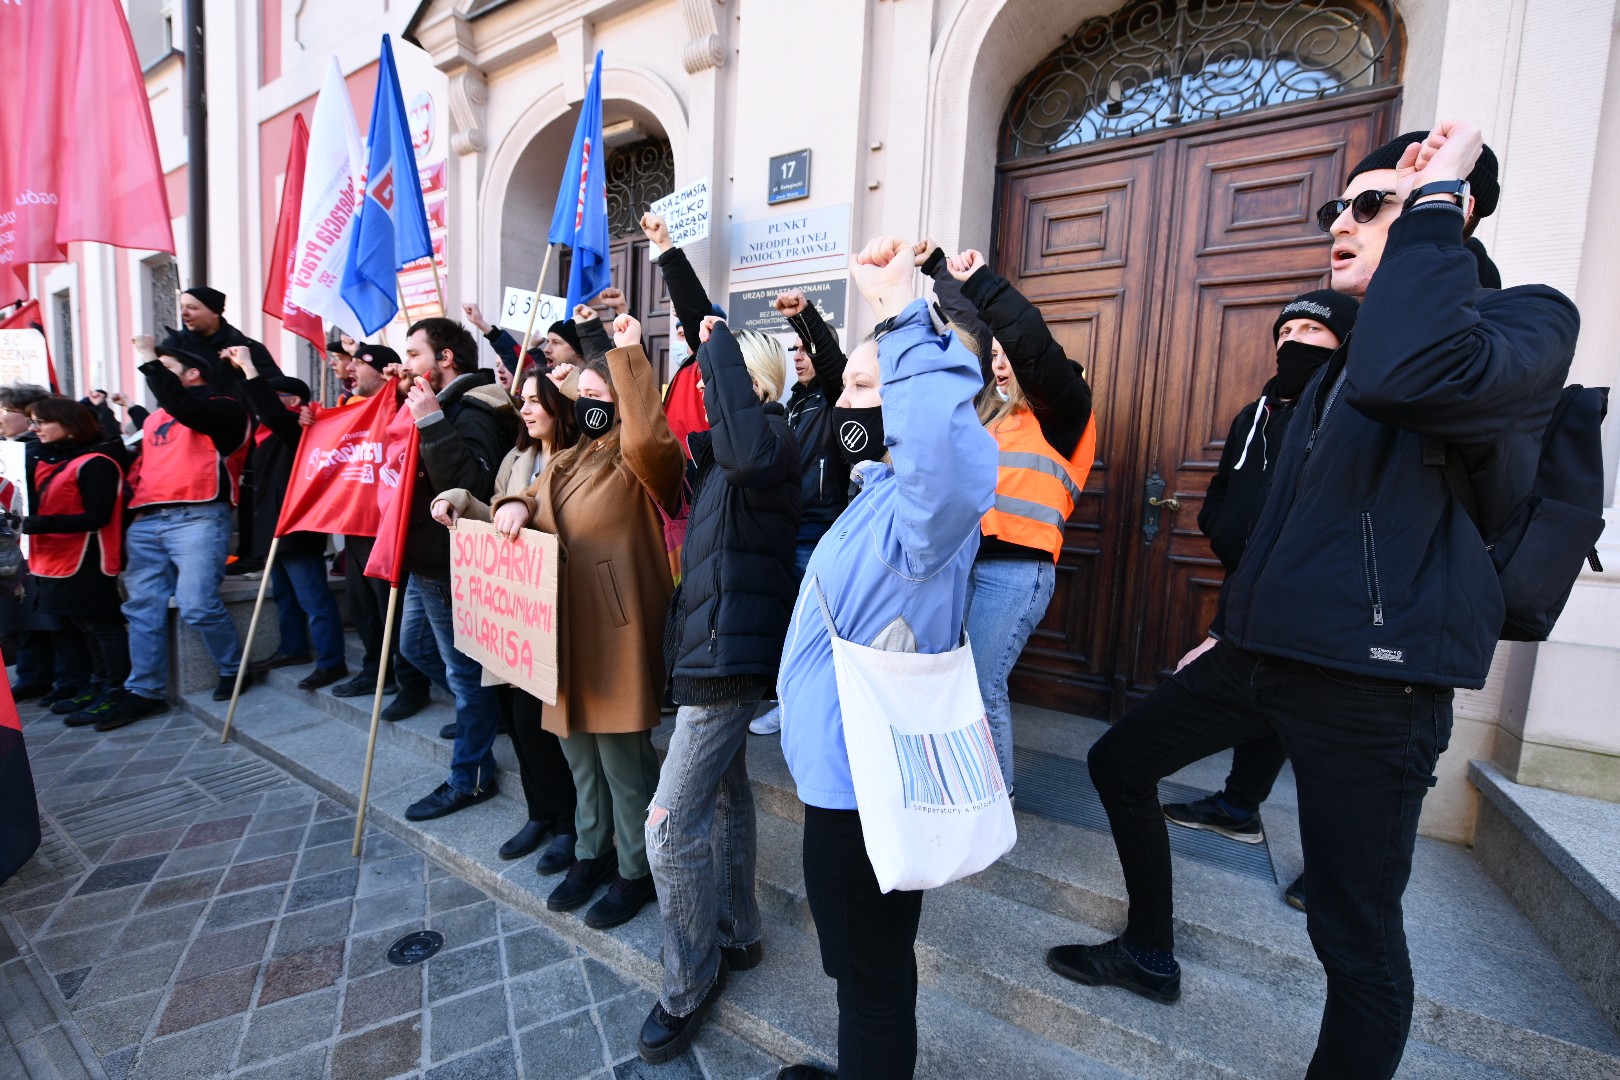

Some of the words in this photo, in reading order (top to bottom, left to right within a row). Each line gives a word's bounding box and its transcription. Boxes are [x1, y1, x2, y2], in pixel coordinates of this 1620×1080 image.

[781, 160, 796, 180] 17
[681, 183, 707, 201] MIASTA
[670, 199, 704, 221] TYLKO
[669, 211, 708, 234] ZARZĄDU
[672, 222, 705, 243] LARIS!!
[768, 218, 808, 234] PUNKT
[749, 232, 827, 252] NIEODPŁATNEJ
[740, 250, 784, 265] POMOCY
[786, 242, 837, 257] PRAWNEJ
[742, 291, 765, 300] URZĄD
[793, 283, 831, 293] OZNANIA
[508, 294, 518, 317] 8
[454, 532, 543, 589] SOLIDARNI
[454, 574, 465, 601] Z
[468, 575, 553, 634] PRACOWNIKAMI
[457, 607, 533, 680] SOLARISA
[913, 803, 961, 814] temperatury
